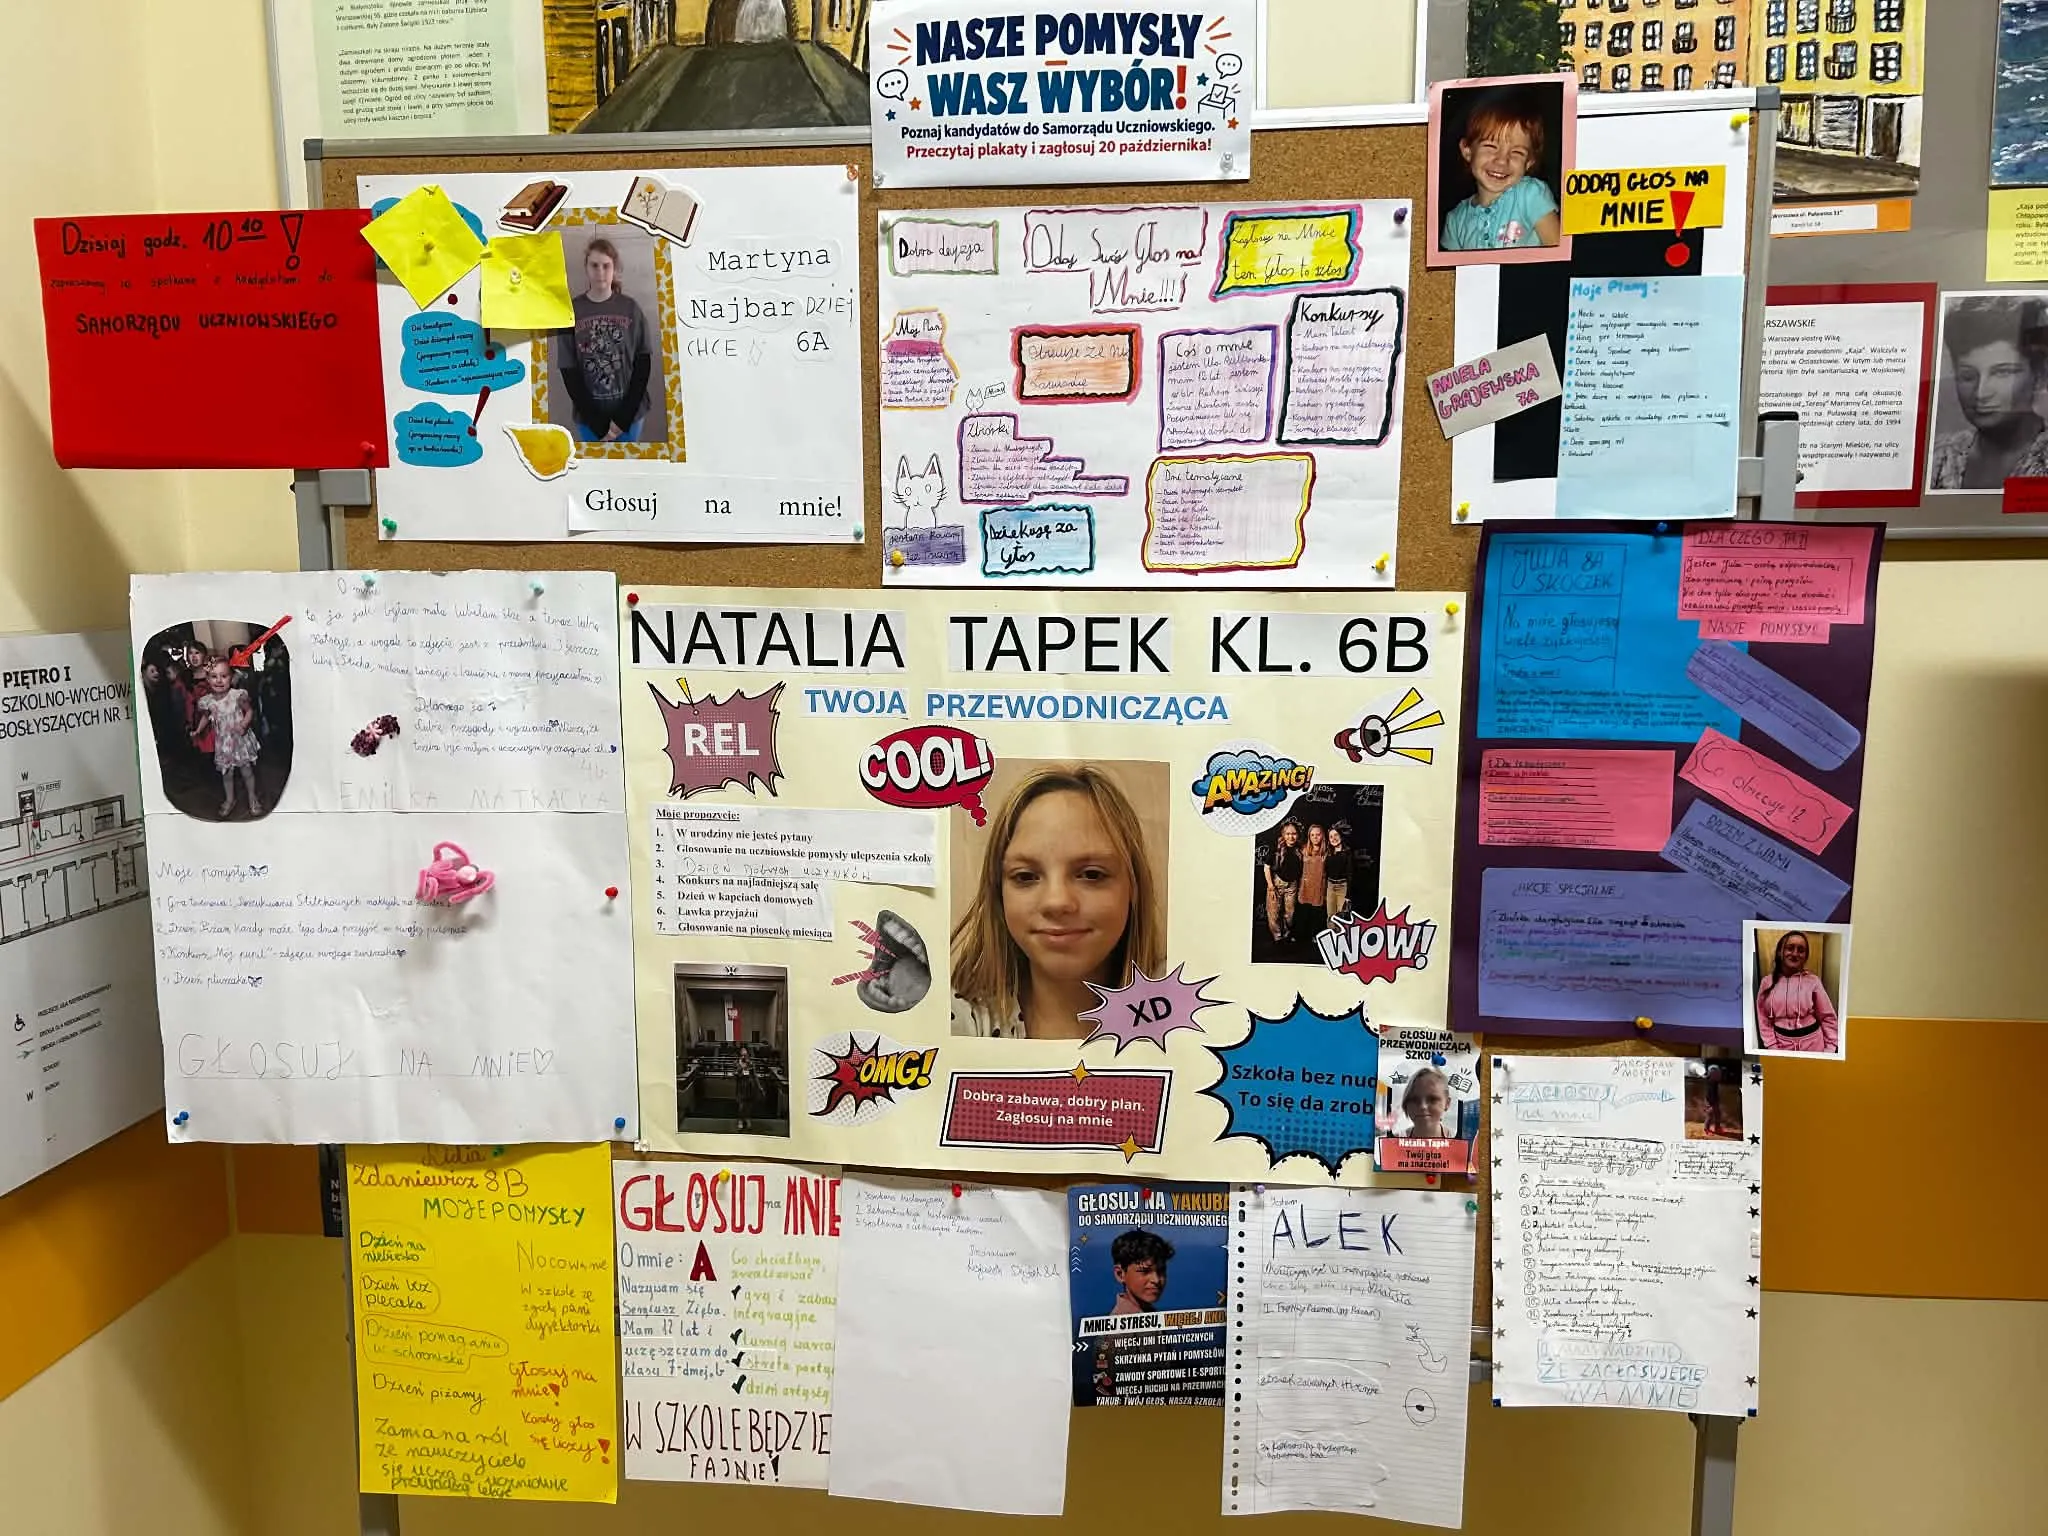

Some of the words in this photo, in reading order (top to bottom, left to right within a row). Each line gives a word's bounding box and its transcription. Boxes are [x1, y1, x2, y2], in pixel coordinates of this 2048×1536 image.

[916, 15, 1025, 66] NASZE
[1035, 13, 1204, 60] POMYSŁY
[927, 71, 1027, 117] WASZ
[1036, 59, 1188, 114] WYBÓR!
[901, 126, 941, 141] Poznaj
[944, 123, 1020, 139] kandydatów
[1023, 121, 1040, 136] do
[1042, 120, 1113, 136] Samorządu
[1115, 119, 1216, 135] Uczniowskiego.
[906, 143, 974, 160] Przeczytaj
[978, 141, 1027, 158] plakaty
[1039, 140, 1095, 157] zagłosuj
[1098, 139, 1115, 154] 20
[1566, 169, 1621, 196] ODDAJ
[1627, 172, 1676, 192] GŁOS
[1684, 169, 1709, 187] NA
[1600, 199, 1665, 226] MNIE
[62, 222, 126, 257] Dzisiaj
[144, 228, 187, 257] godz.
[708, 248, 832, 273] Martyna
[691, 297, 796, 324] Najbar
[1300, 302, 1384, 331] Konkursy
[76, 313, 181, 338] SAMORZĄDU
[199, 312, 338, 330] UCZNIOWSKIEGO
[796, 331, 830, 352] 6A
[1768, 335, 1800, 343] Warszawy
[1431, 357, 1492, 398] ANIELA
[1438, 361, 1540, 421] GRAJEWSKA
[586, 489, 658, 520] Głosuj
[704, 497, 732, 515] na
[779, 496, 842, 518] mnie!
[631, 610, 905, 668] NATALIA
[949, 615, 1170, 673] TAPEK
[1212, 616, 1312, 673] KL.
[1338, 616, 1429, 673] 6B
[3, 667, 60, 689] PIĘTRO
[64, 666, 71, 681] I
[104, 707, 121, 723] NR
[804, 689, 907, 715] TWOJA
[926, 693, 1229, 725] PRZEWODNICZĄCA
[683, 722, 761, 757] REL
[860, 736, 995, 791] COOL!
[1202, 766, 1314, 815] AMAZING!
[656, 808, 681, 820] Moje
[684, 810, 740, 822] propozycje:
[676, 828, 688, 838] W
[690, 829, 733, 841] urodziny
[736, 830, 750, 839] nie
[752, 830, 778, 842] jesteś
[780, 833, 813, 844] pytany
[749, 846, 804, 858] uczniowskie
[850, 851, 900, 862] ulepszenia
[677, 876, 720, 886] Konkurs
[723, 878, 734, 886] na
[677, 891, 705, 901] Dzień
[718, 892, 761, 904] kapciach
[763, 895, 813, 906] domowych
[736, 926, 748, 934] na
[1317, 924, 1436, 970] WOW!
[1126, 996, 1172, 1028] XD
[1380, 1039, 1471, 1054] PRZEWODNICZĄCĄ
[1399, 1030, 1437, 1042] GŁOSUJ
[1439, 1032, 1453, 1042] NA
[178, 1032, 356, 1080] GŁOSUJ
[400, 1047, 433, 1076] NA
[859, 1048, 938, 1090] OMG!
[1231, 1064, 1295, 1082] Szkoła
[1302, 1066, 1336, 1085] bez
[962, 1089, 1004, 1104] Dobra
[1007, 1092, 1064, 1108] zabawa,
[1067, 1095, 1107, 1111] dobry
[1111, 1098, 1146, 1112] plan.
[1239, 1091, 1261, 1107] To
[1267, 1094, 1294, 1112] się
[1300, 1095, 1324, 1113] da
[996, 1110, 1053, 1128] Zagłosuj
[1057, 1114, 1074, 1125] na
[1078, 1114, 1113, 1127] mnie
[1405, 1150, 1425, 1160] Twój
[620, 1172, 765, 1234] GŁOSUJ
[765, 1199, 781, 1209] na
[1078, 1192, 1139, 1211] GŁOSUJ
[1144, 1191, 1166, 1210] NA
[1079, 1215, 1091, 1226] DO
[1095, 1214, 1154, 1228] SAMORZĄDU
[1157, 1213, 1228, 1227] UCZNIOWSKIEG
[1272, 1204, 1404, 1260] ALEK
[621, 1275, 679, 1300] Nazywam
[623, 1321, 653, 1335] Mam
[680, 1320, 700, 1336] lat
[1084, 1318, 1119, 1334] MNIEJ
[1120, 1315, 1162, 1331] STRESU,
[714, 1345, 728, 1358] do
[1114, 1338, 1141, 1350] WIĘCEJ
[1158, 1332, 1214, 1345] TEMATYCZNYCH
[1154, 1351, 1177, 1363] PYTAŃ
[508, 1361, 568, 1387] Głosuj
[1115, 1371, 1146, 1382] ZAWODY
[1147, 1369, 1186, 1380] SPORTOWE
[624, 1399, 642, 1451] W
[655, 1401, 742, 1454] SZKOLE
[749, 1408, 832, 1458] BĘDZIE
